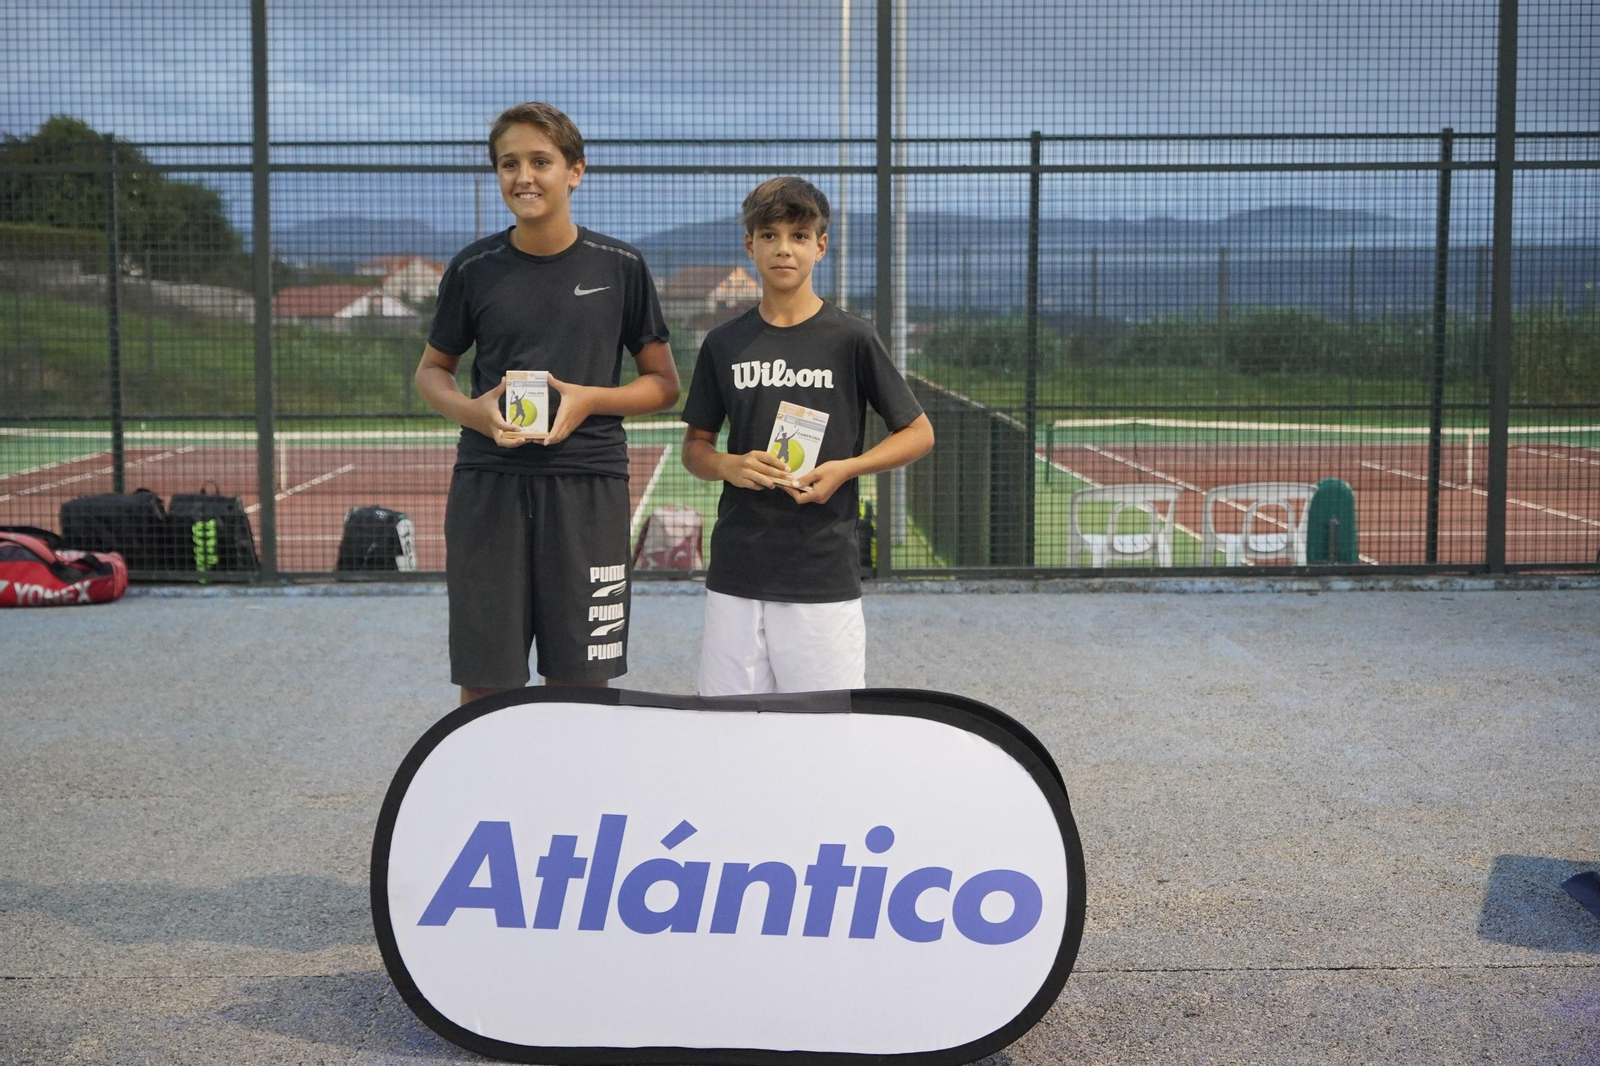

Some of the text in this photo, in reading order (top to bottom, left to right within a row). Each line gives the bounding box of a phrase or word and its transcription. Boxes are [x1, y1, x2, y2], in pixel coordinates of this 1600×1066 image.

[731, 359, 834, 390] Wilson
[590, 564, 625, 583] PUMA
[13, 580, 91, 606] YONEX
[588, 603, 624, 622] PUMA
[587, 641, 623, 661] PUMA
[416, 813, 1043, 946] Atlántico
